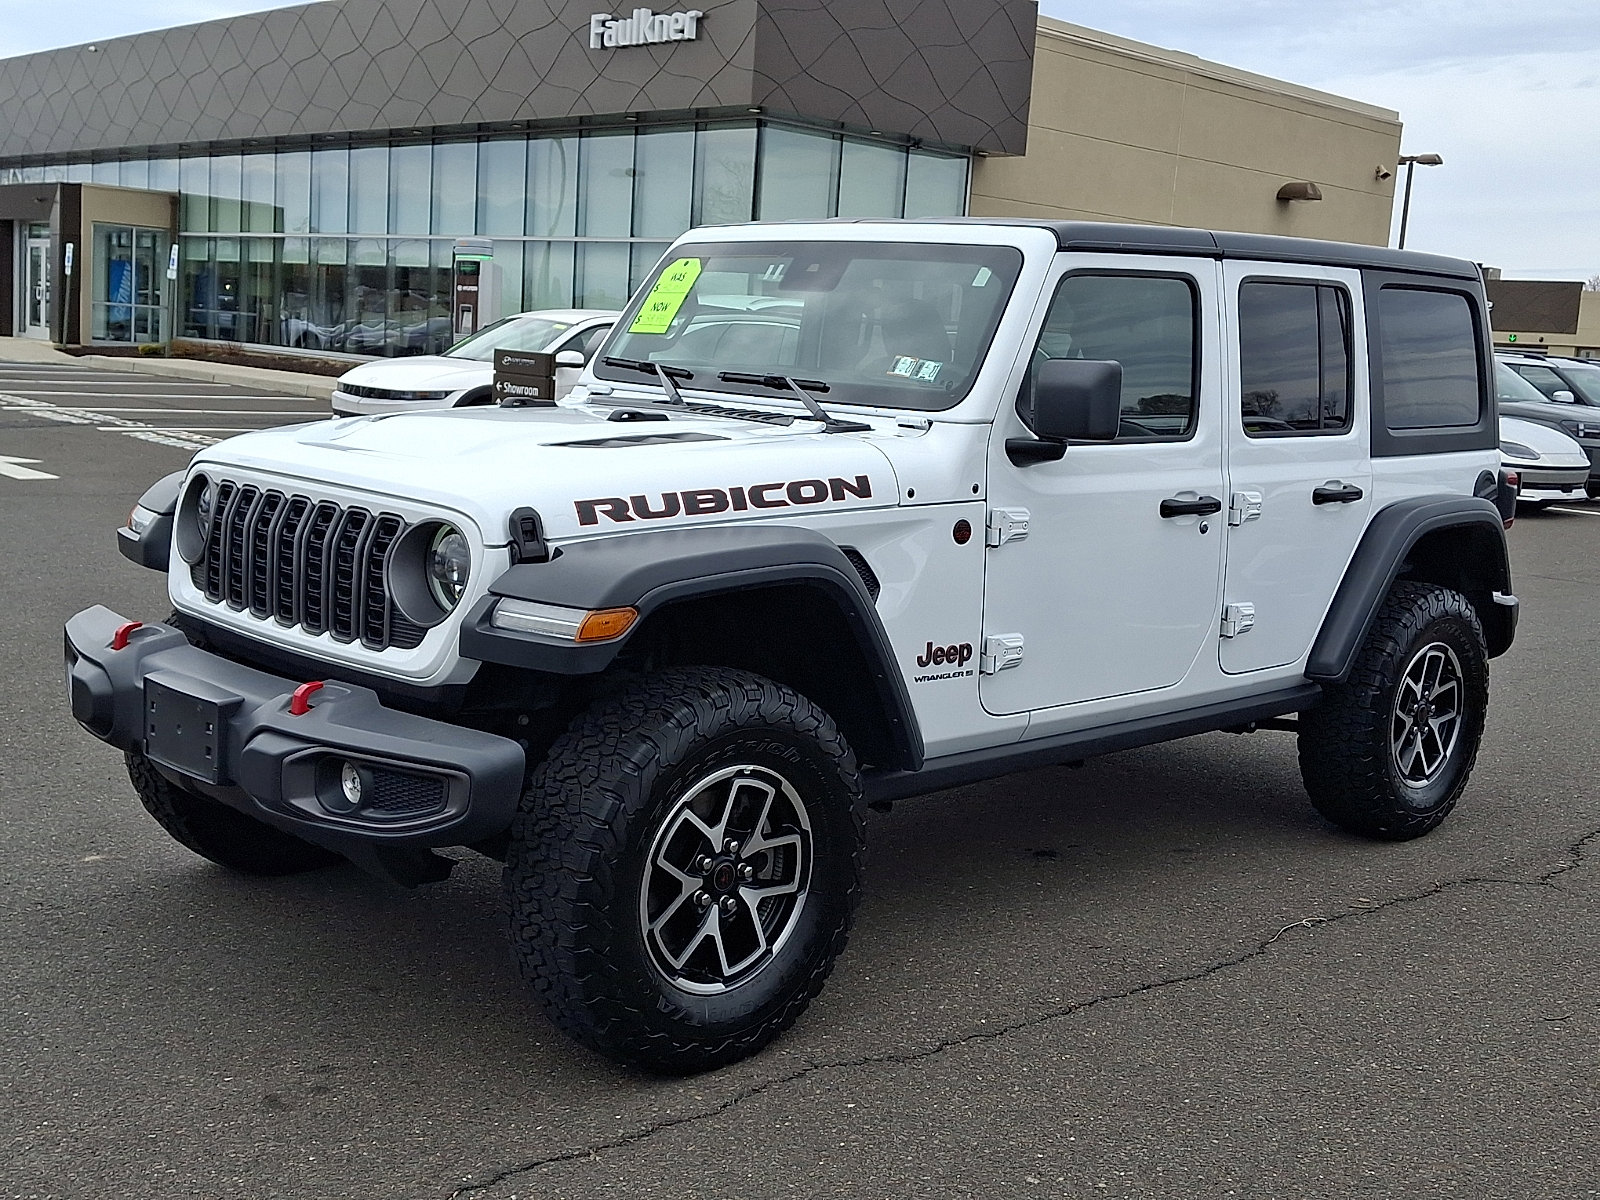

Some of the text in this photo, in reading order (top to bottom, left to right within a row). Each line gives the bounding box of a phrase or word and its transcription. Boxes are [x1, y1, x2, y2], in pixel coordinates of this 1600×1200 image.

[590, 8, 703, 49] Faulkner
[650, 302, 671, 311] NOW
[503, 381, 539, 396] Showroom
[574, 474, 873, 526] RUBICON
[916, 641, 973, 668] Jeep
[913, 671, 965, 683] WRANGLER
